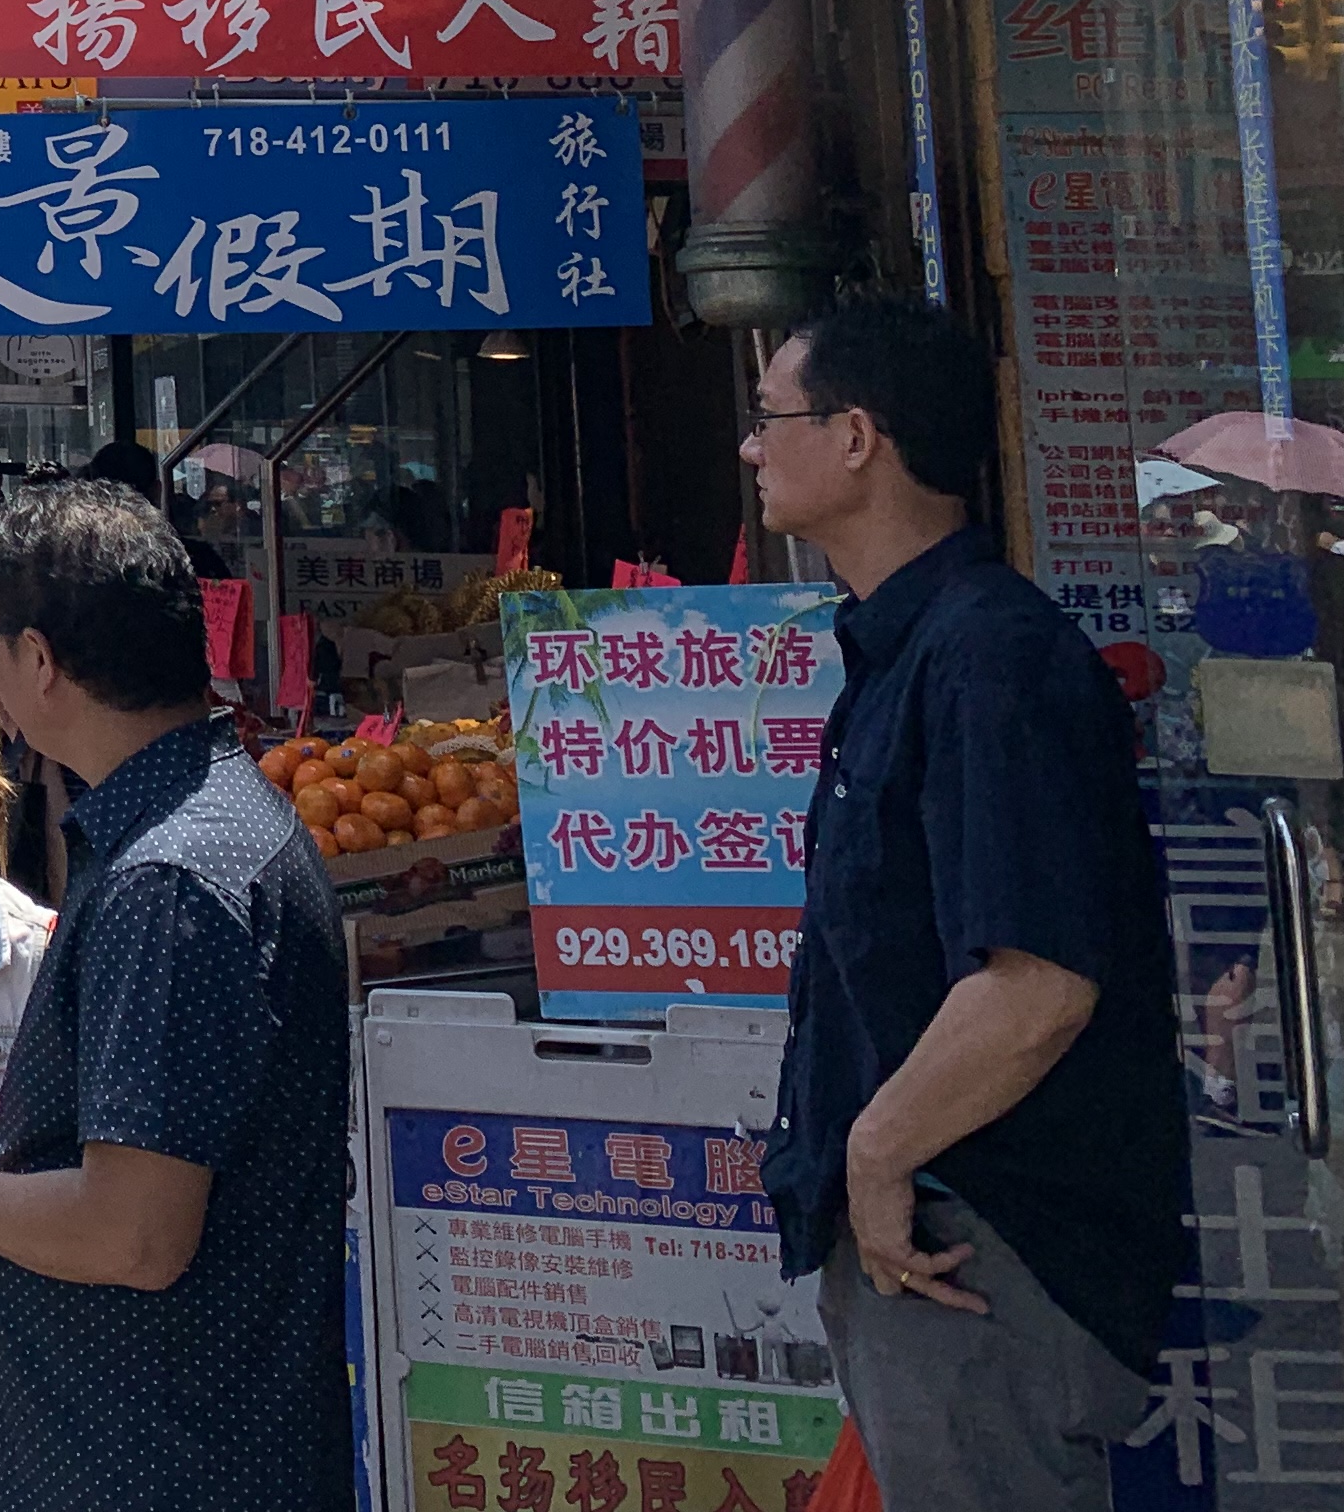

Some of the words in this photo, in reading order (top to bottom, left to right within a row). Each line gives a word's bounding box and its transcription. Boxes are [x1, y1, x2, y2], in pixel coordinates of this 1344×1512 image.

[204, 121, 452, 157] 718-412-0111
[548, 111, 617, 308] 旅行社
[527, 626, 817, 692] 环球旅游
[540, 716, 828, 778] 特价机票
[448, 860, 516, 883] Market
[338, 884, 389, 907] mers
[555, 926, 800, 969] 929.369.188
[422, 1181, 517, 1209] eStar
[527, 1185, 739, 1227] Technology
[644, 1235, 684, 1258] Tel:
[690, 1240, 782, 1265] 718-321-
[483, 1375, 783, 1446] 信箱出租
